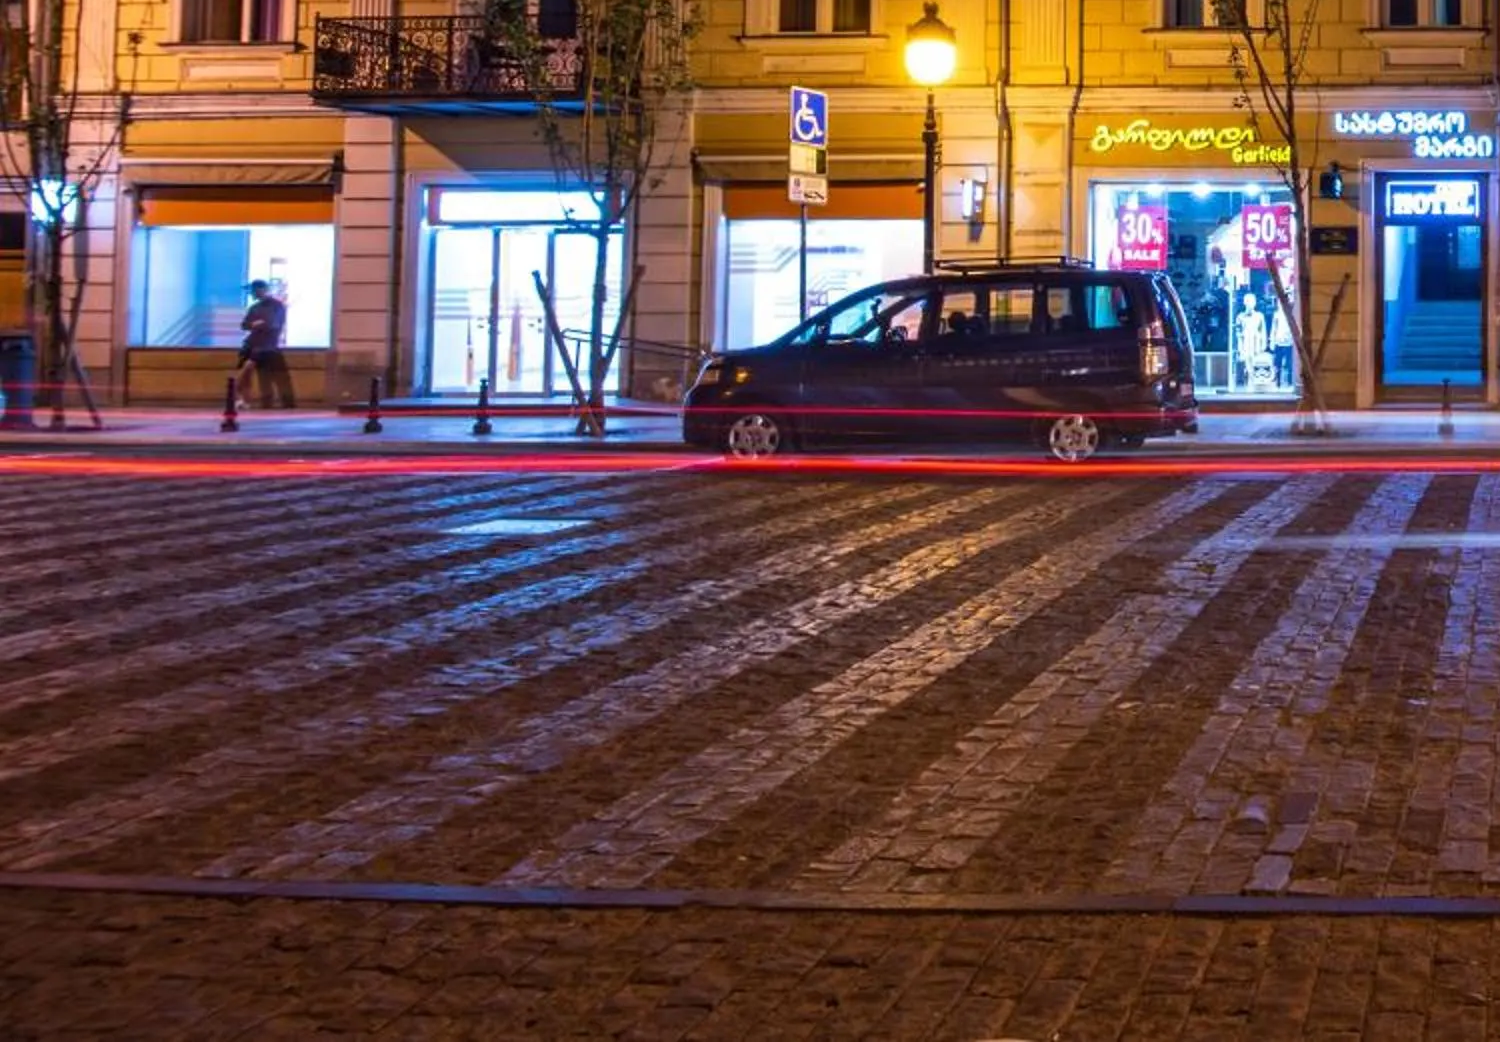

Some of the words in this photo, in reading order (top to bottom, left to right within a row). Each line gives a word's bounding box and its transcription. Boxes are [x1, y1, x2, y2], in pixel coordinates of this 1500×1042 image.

[1335, 111, 1465, 134] სასტუმრო
[1232, 145, 1291, 163] Garfield
[1415, 135, 1493, 157] მარგი
[1121, 212, 1164, 244] 30%
[1246, 212, 1288, 243] 50%
[1124, 249, 1160, 260] SALE
